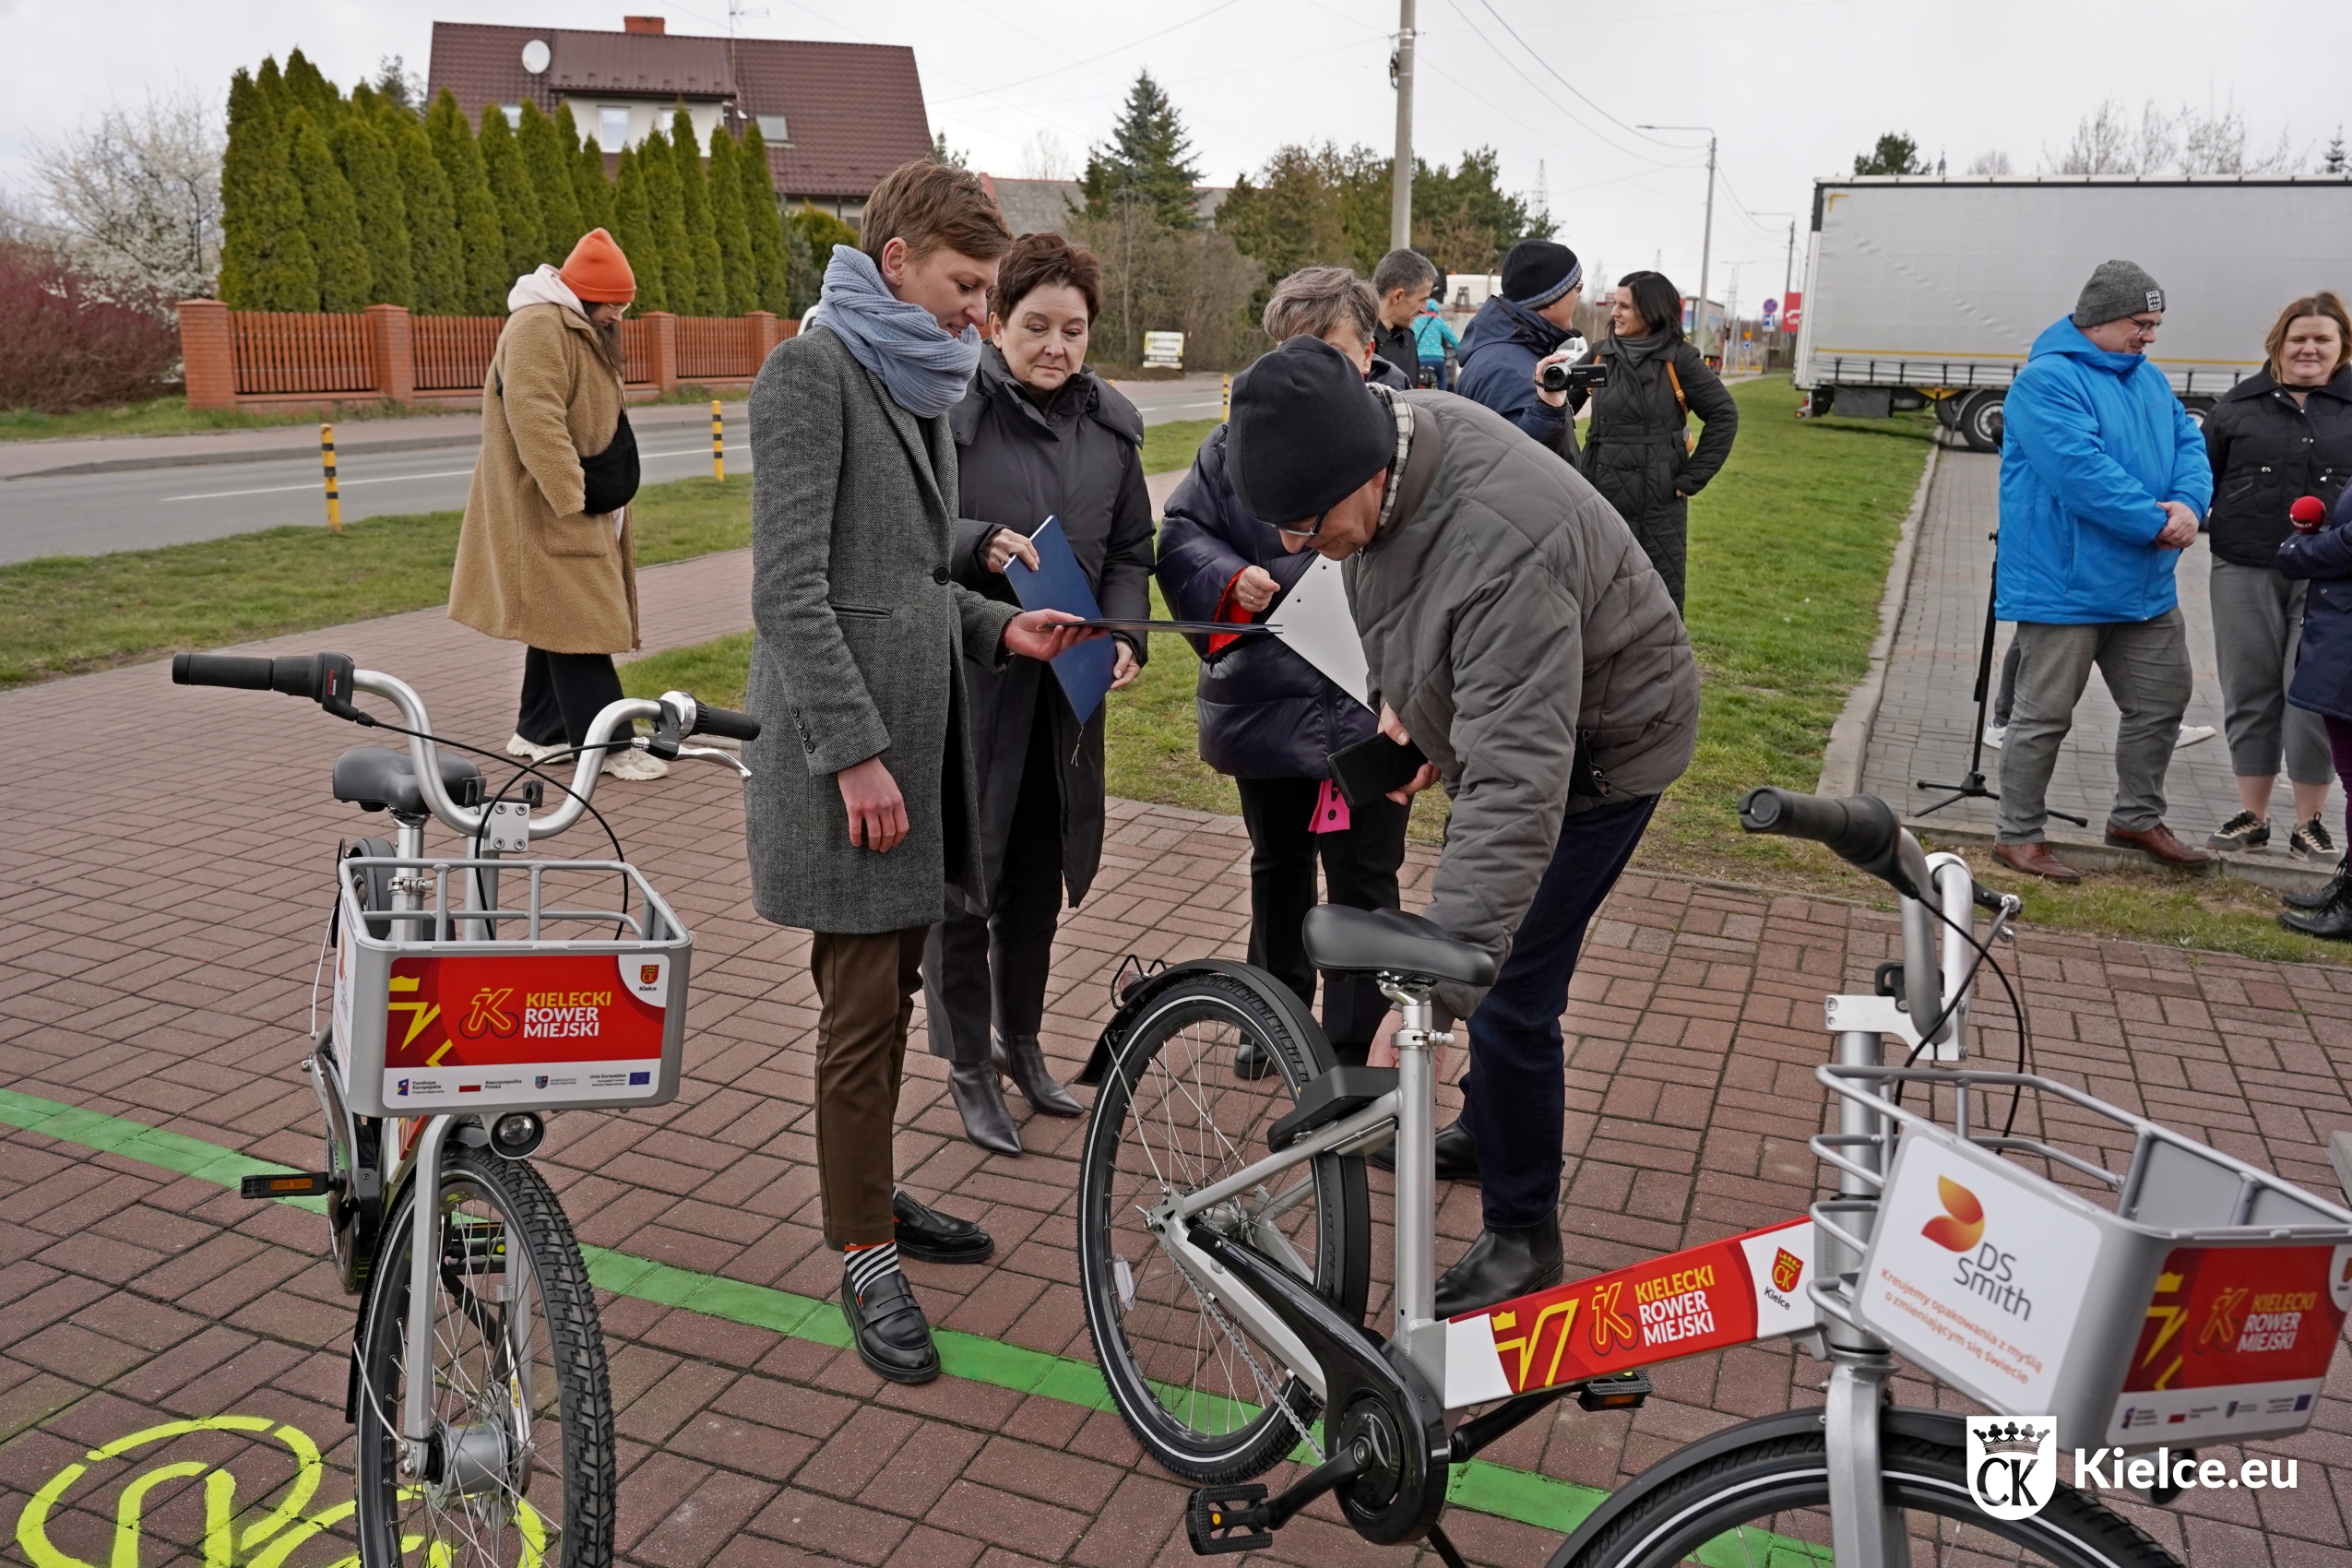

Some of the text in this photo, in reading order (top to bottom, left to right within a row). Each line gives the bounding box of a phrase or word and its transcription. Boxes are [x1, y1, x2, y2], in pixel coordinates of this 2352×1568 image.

[525, 1006, 600, 1023] ROWER
[526, 992, 612, 1008] KIELECKI
[523, 1021, 600, 1039] MIEJSKI
[1977, 1241, 2017, 1283] DS
[1634, 1265, 1716, 1304] KIELECKI
[1764, 1287, 1791, 1311] Kielce
[1954, 1256, 2033, 1323] Smith
[1638, 1289, 1710, 1326] ROWER
[2250, 1292, 2318, 1313] KIELECKI
[1642, 1311, 1716, 1348] MIEJSKI
[1880, 1267, 2044, 1374] Kreujemy opakowania z myślą
[2243, 1312, 2302, 1333] ROWER
[1884, 1291, 2030, 1384] o zmieniającym się świecie
[2236, 1331, 2298, 1353] MIEJSKI
